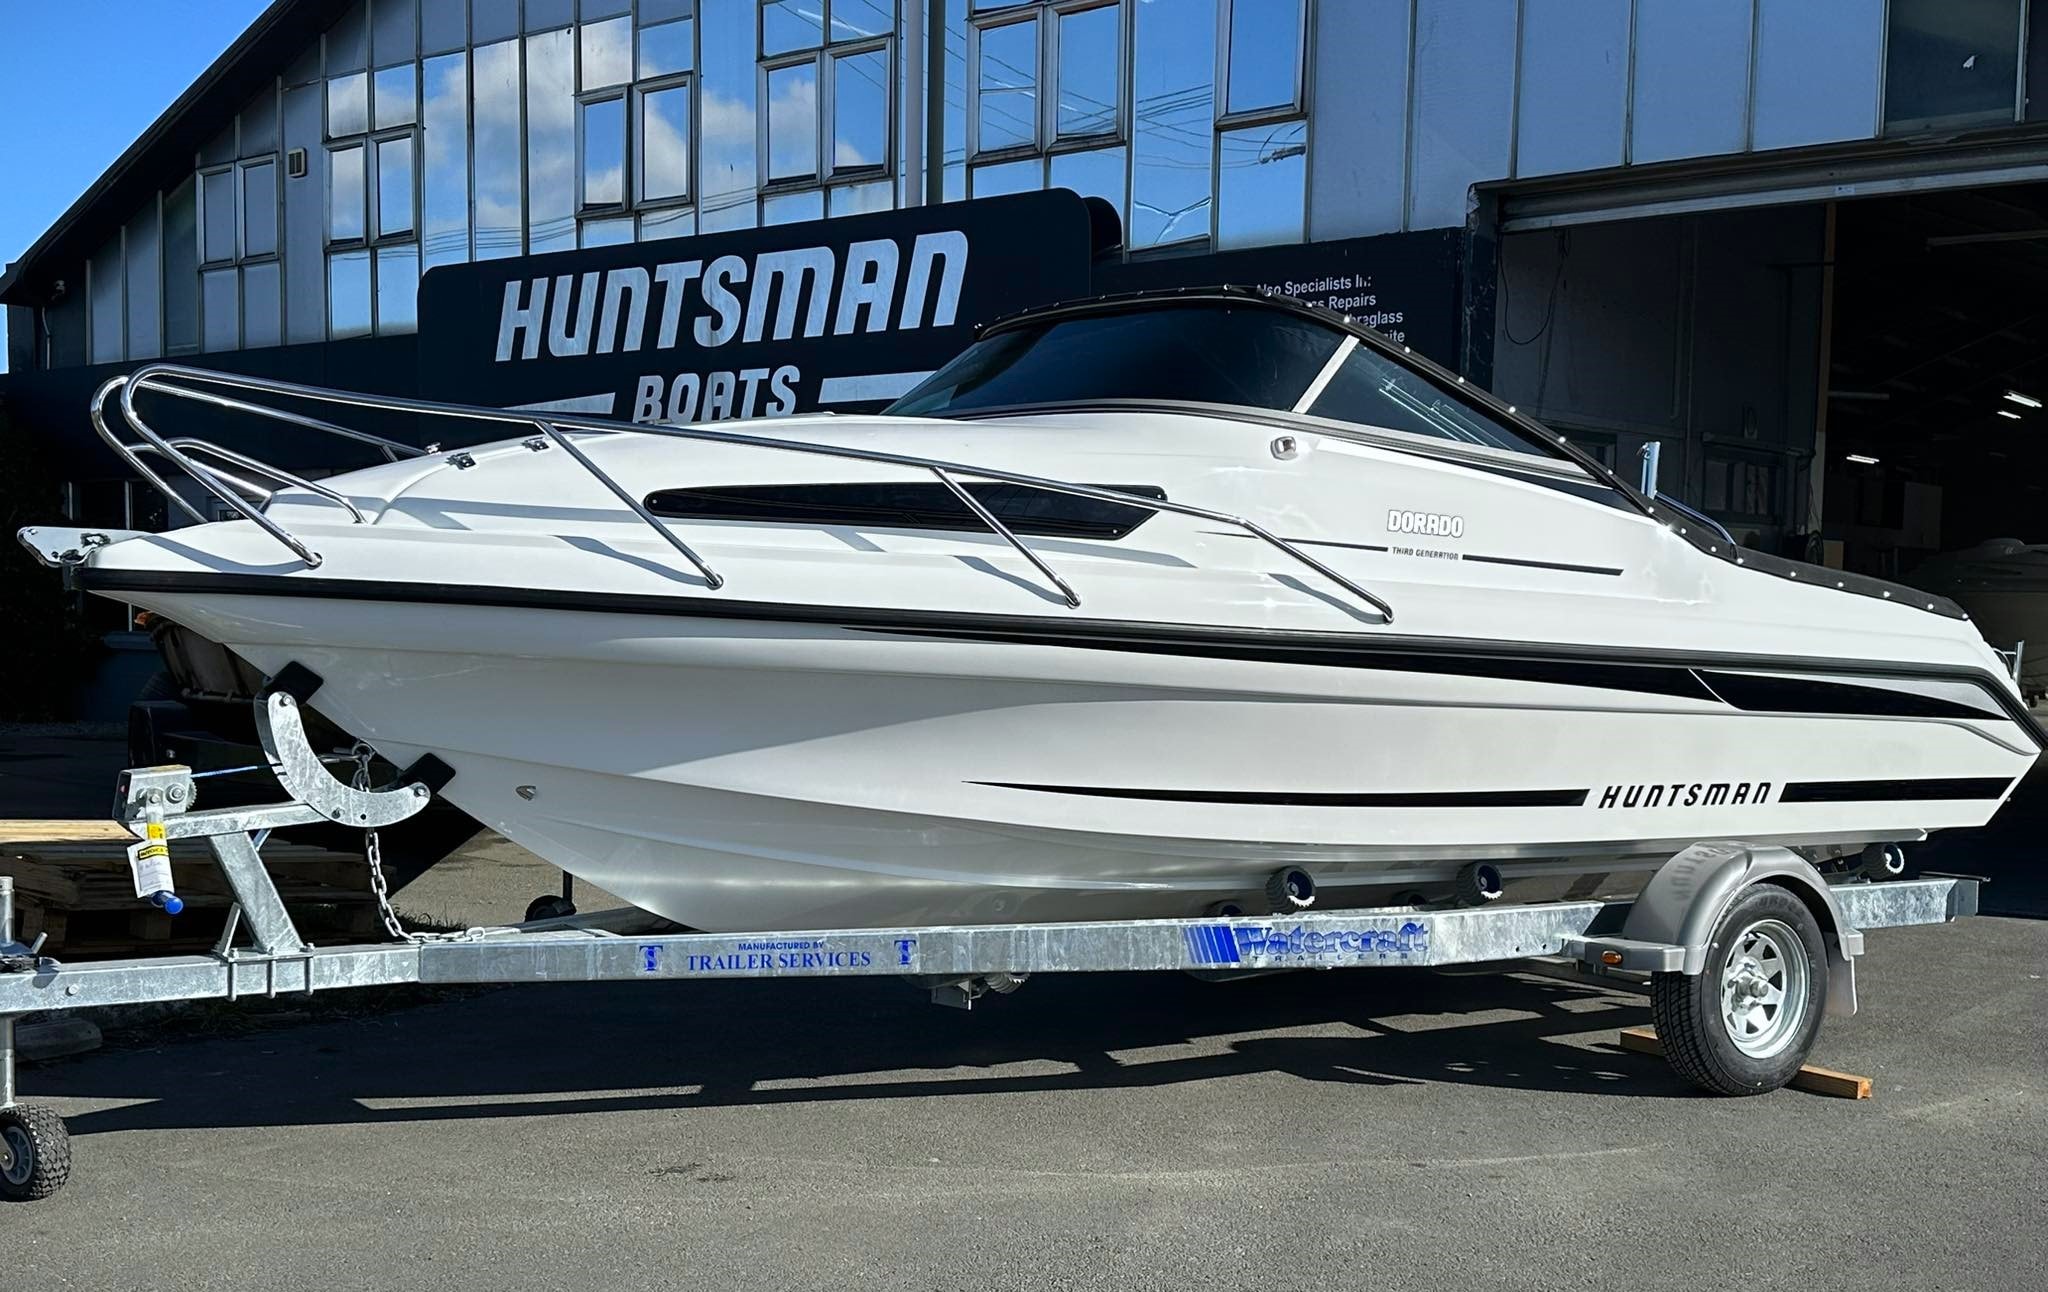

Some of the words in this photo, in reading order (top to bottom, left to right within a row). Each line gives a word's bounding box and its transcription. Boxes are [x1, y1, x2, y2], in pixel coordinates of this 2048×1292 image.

[495, 230, 969, 362] HUNTSMAN
[1285, 276, 1352, 297] Specialists
[1328, 293, 1377, 311] Repairs
[632, 365, 800, 424] BOATS
[1387, 509, 1464, 538] DORADO
[1392, 546, 1414, 556] THIRD
[1416, 549, 1459, 561] GENERATION
[1598, 782, 1771, 809] HUNTSMAN
[738, 942, 810, 951] MANUFACTURED
[812, 940, 825, 949] BY
[1233, 922, 1429, 956] Watercraft
[686, 954, 773, 971] TRAILER
[779, 951, 871, 968] SERVICES
